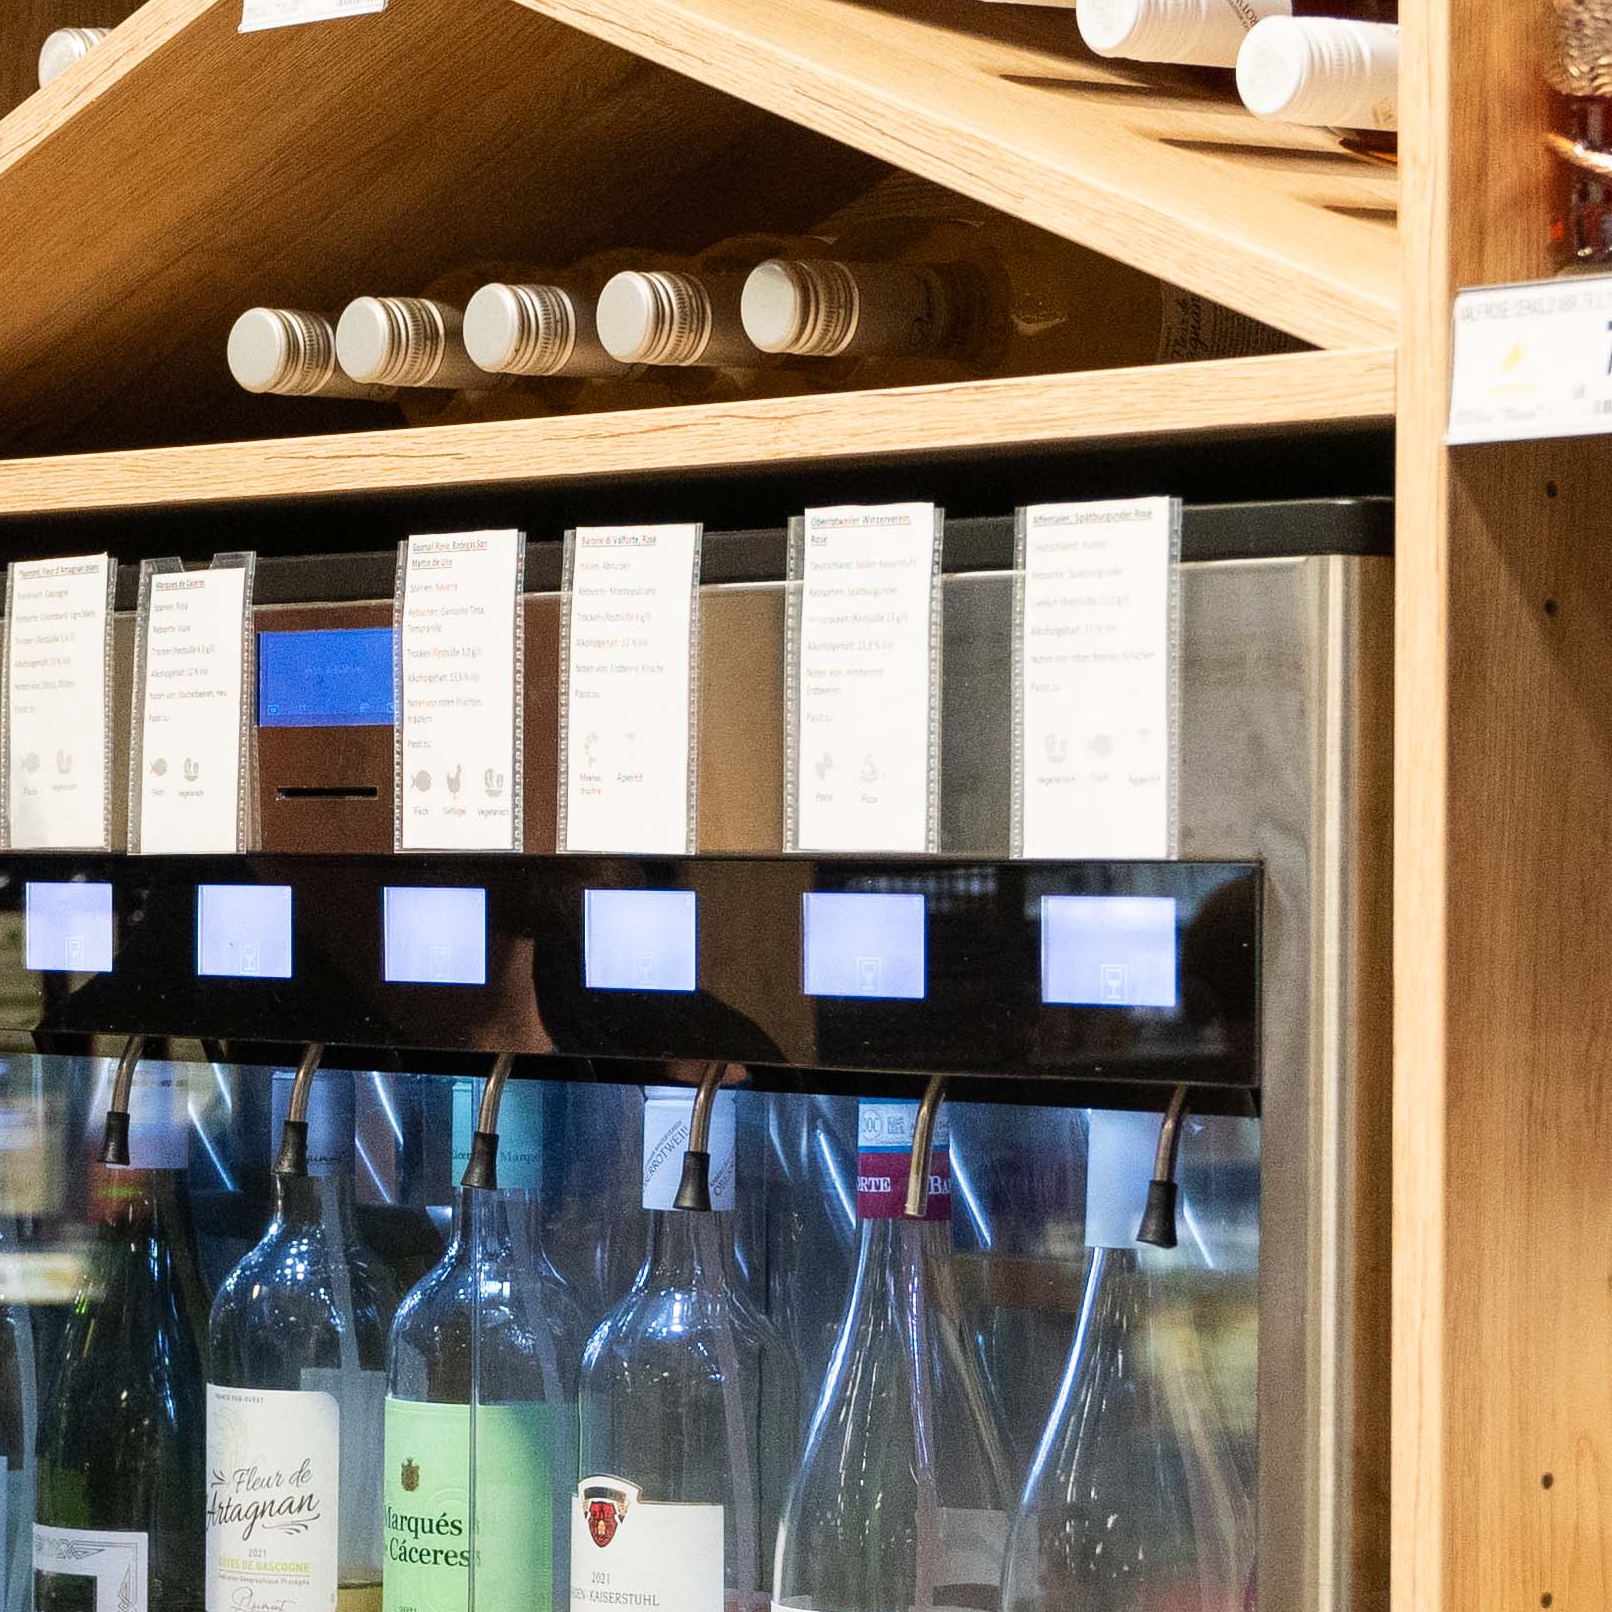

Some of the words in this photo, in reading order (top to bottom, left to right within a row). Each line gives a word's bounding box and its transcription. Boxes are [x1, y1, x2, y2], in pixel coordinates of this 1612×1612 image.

[233, 1466, 283, 1493] Fleur
[289, 1458, 313, 1488] de
[248, 1547, 267, 1558] 2021
[390, 1537, 470, 1568] Cáceres
[241, 1558, 253, 1570] DE
[255, 1560, 309, 1573] GASCOGNE
[591, 1571, 610, 1585] 2021
[589, 1590, 660, 1606] KAISERSTUHL
